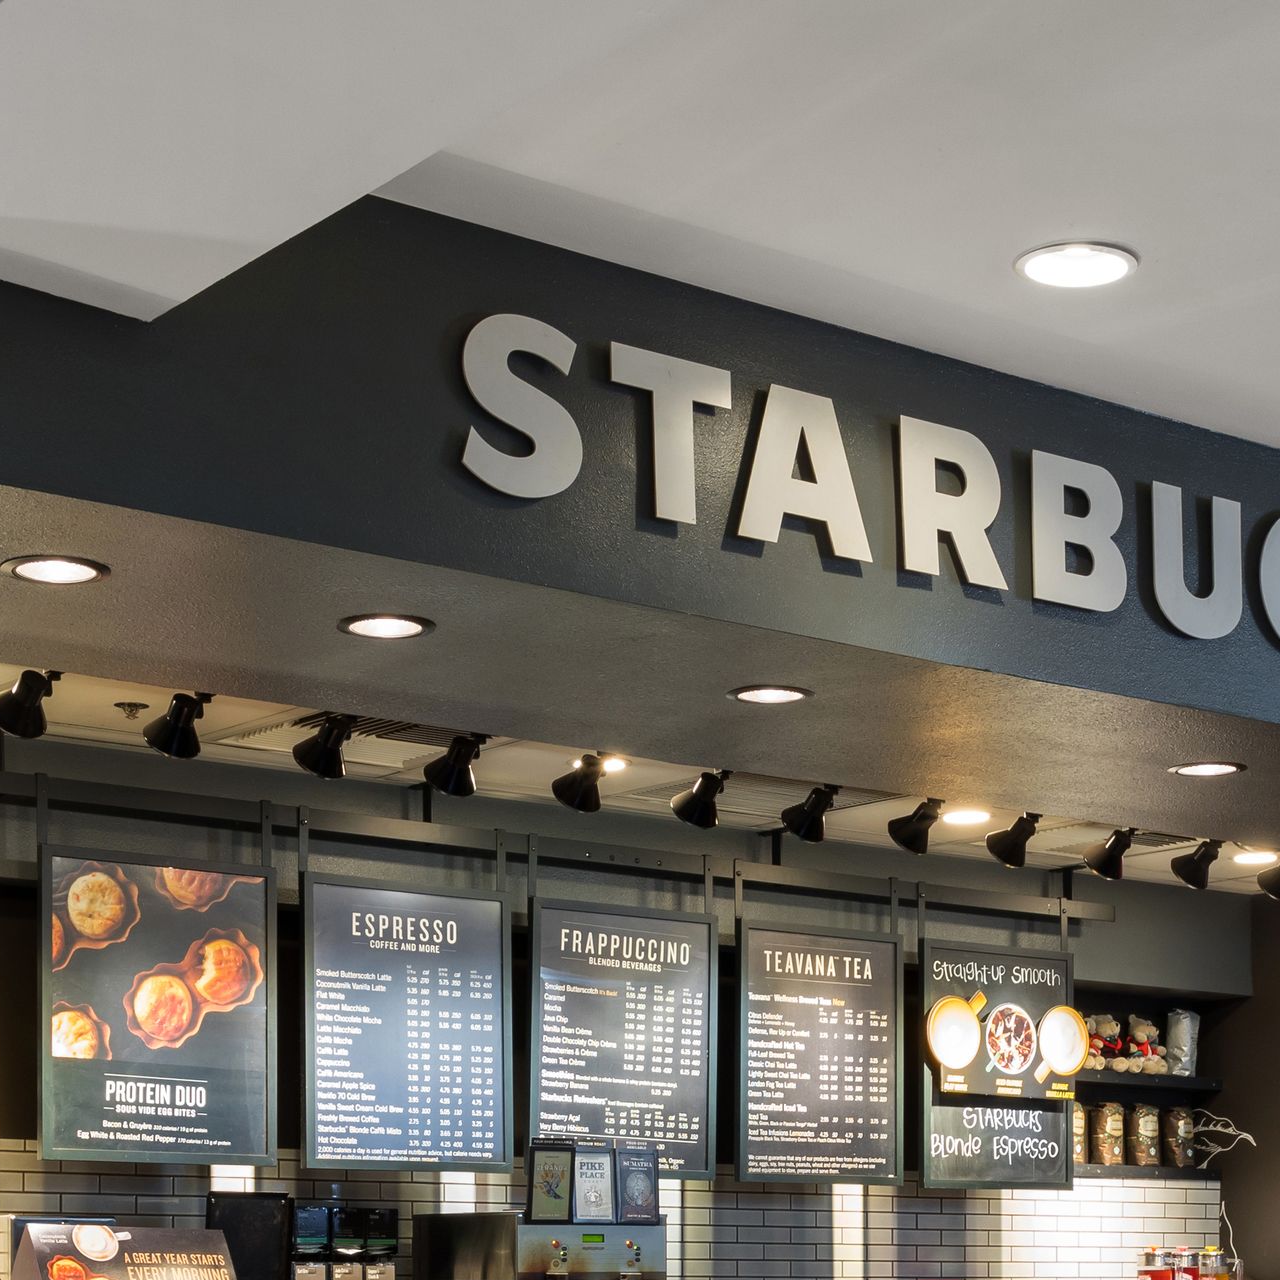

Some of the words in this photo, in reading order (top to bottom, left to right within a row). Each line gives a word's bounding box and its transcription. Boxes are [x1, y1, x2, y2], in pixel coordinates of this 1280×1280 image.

[352, 912, 458, 945] ESPRESSO
[370, 940, 399, 951] COFFEE
[401, 942, 417, 952] AND
[419, 943, 440, 954] MORE
[560, 928, 690, 966] FRAPPUCCINO
[588, 957, 620, 968] BLENDED
[622, 960, 662, 972] BEVERAGES
[843, 956, 872, 980] TEA
[106, 1080, 170, 1106] PROTEIN
[175, 1086, 206, 1108] DUO
[116, 1104, 136, 1114] SOUS
[138, 1106, 156, 1116] VIDE
[157, 1106, 172, 1116] EGG
[174, 1108, 196, 1118] BITES
[102, 1119, 121, 1128] Bacon
[962, 1107, 1042, 1132] STARBUCKS
[77, 1130, 89, 1140] Egg
[90, 1130, 108, 1140] White
[116, 1132, 140, 1142] Roasted
[142, 1133, 154, 1142] Red
[155, 1134, 176, 1144] Pepper
[931, 1134, 982, 1158] Blonde
[994, 1136, 1058, 1165] Espresso
[579, 1162, 604, 1171] PIKE
[623, 1160, 652, 1168] SUMATRA
[124, 1252, 130, 1263] A
[132, 1252, 162, 1264] GREAT
[164, 1253, 188, 1265] YEAR
[192, 1254, 225, 1266] STARTS
